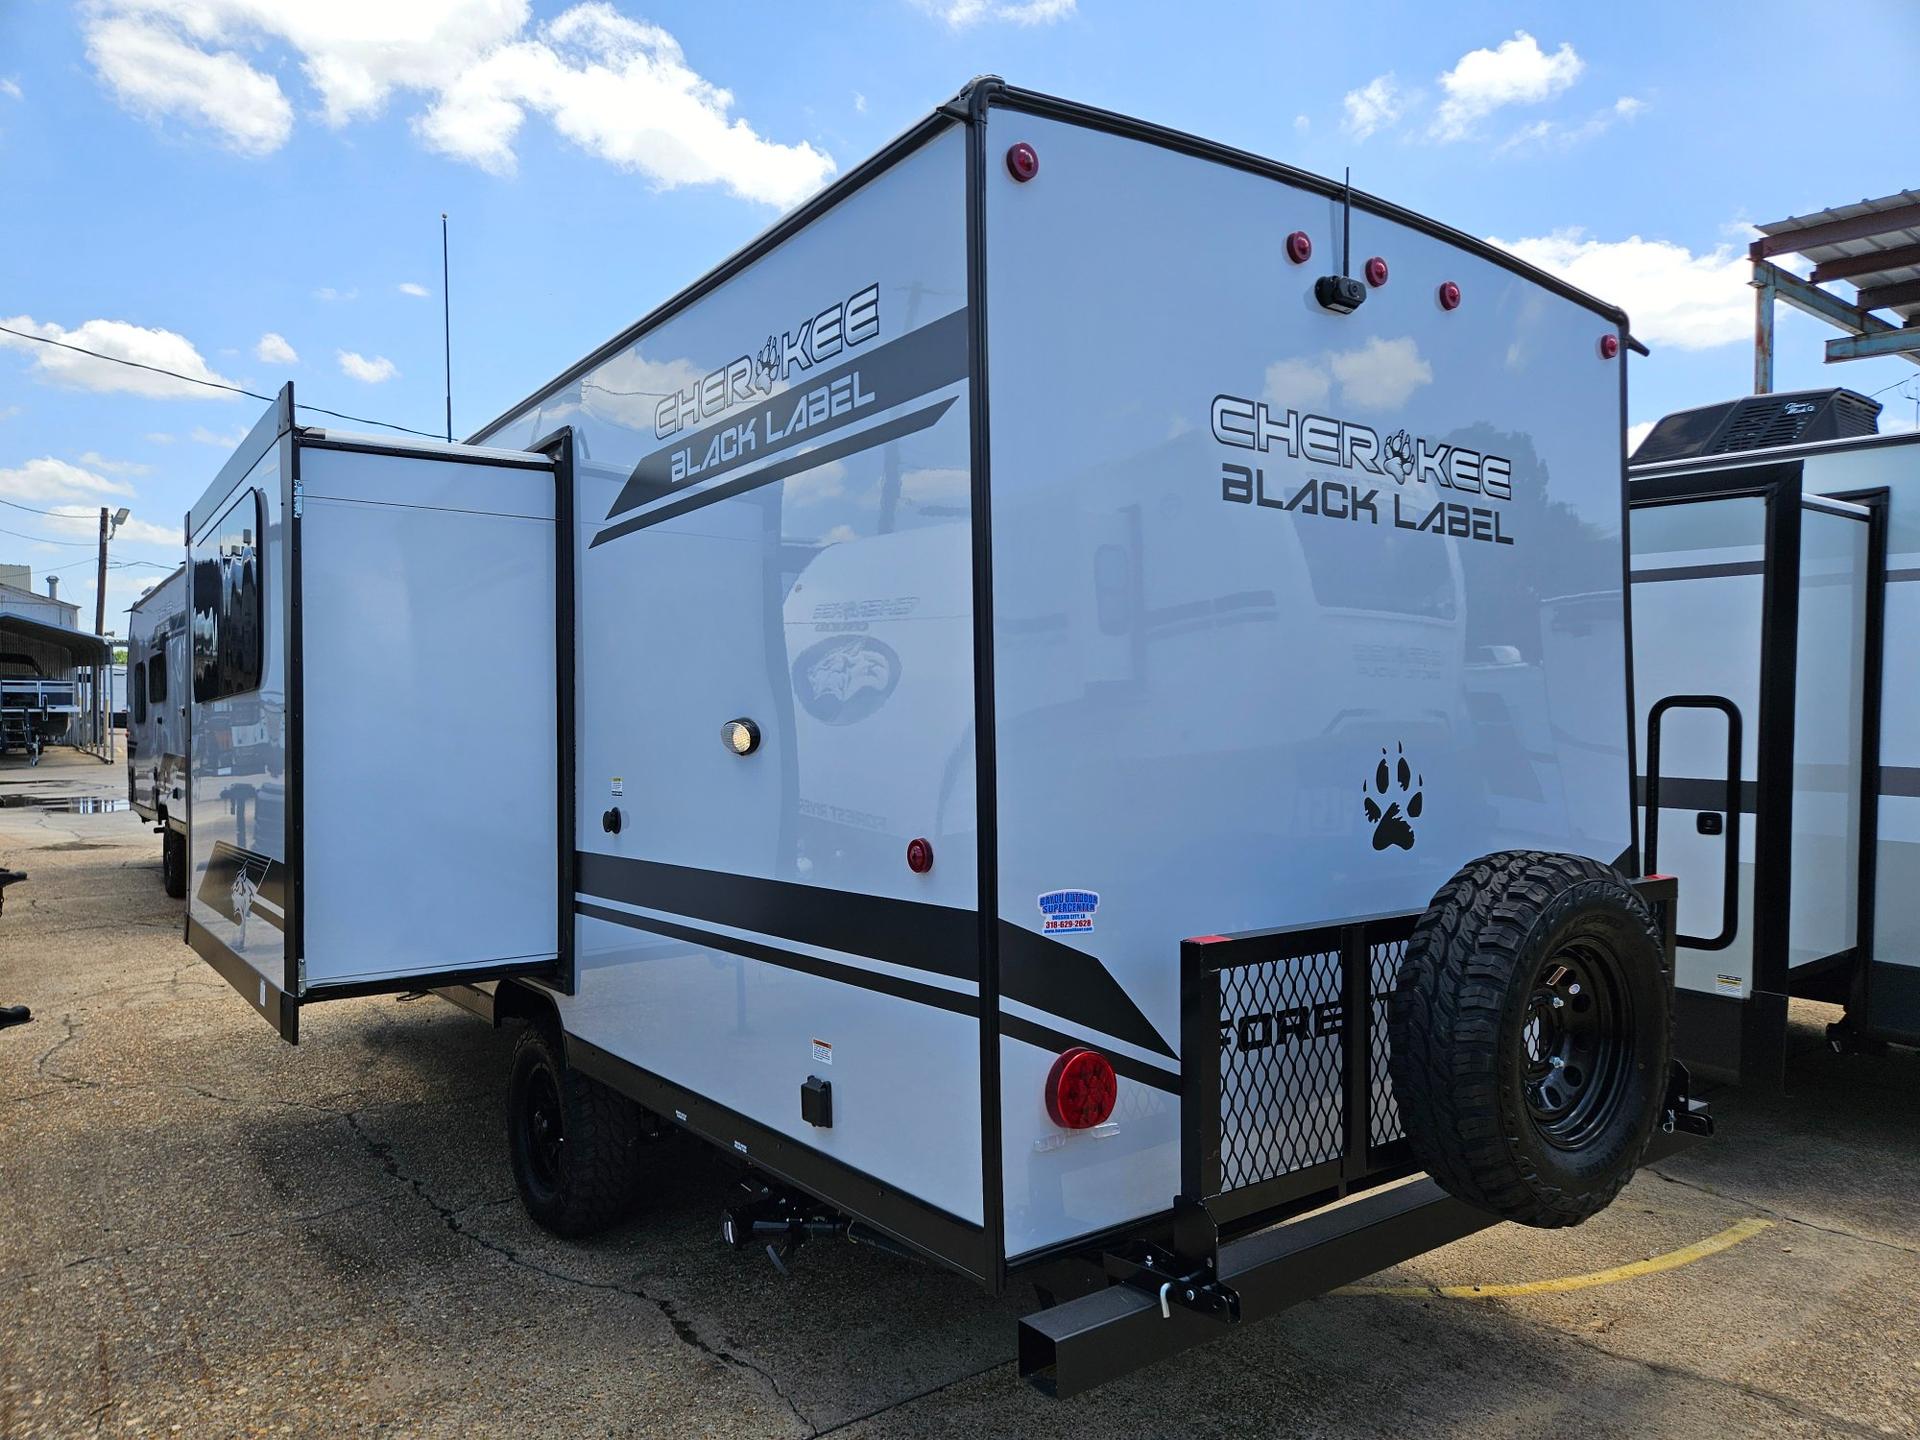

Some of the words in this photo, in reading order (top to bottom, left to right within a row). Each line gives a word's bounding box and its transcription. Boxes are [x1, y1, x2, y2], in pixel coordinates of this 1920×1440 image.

[671, 416, 757, 484] BLACK
[766, 371, 876, 443] LABEL
[1222, 462, 1379, 525] BLACK
[1394, 493, 1515, 545] LABEL
[1043, 903, 1095, 913] SUPERCENTER
